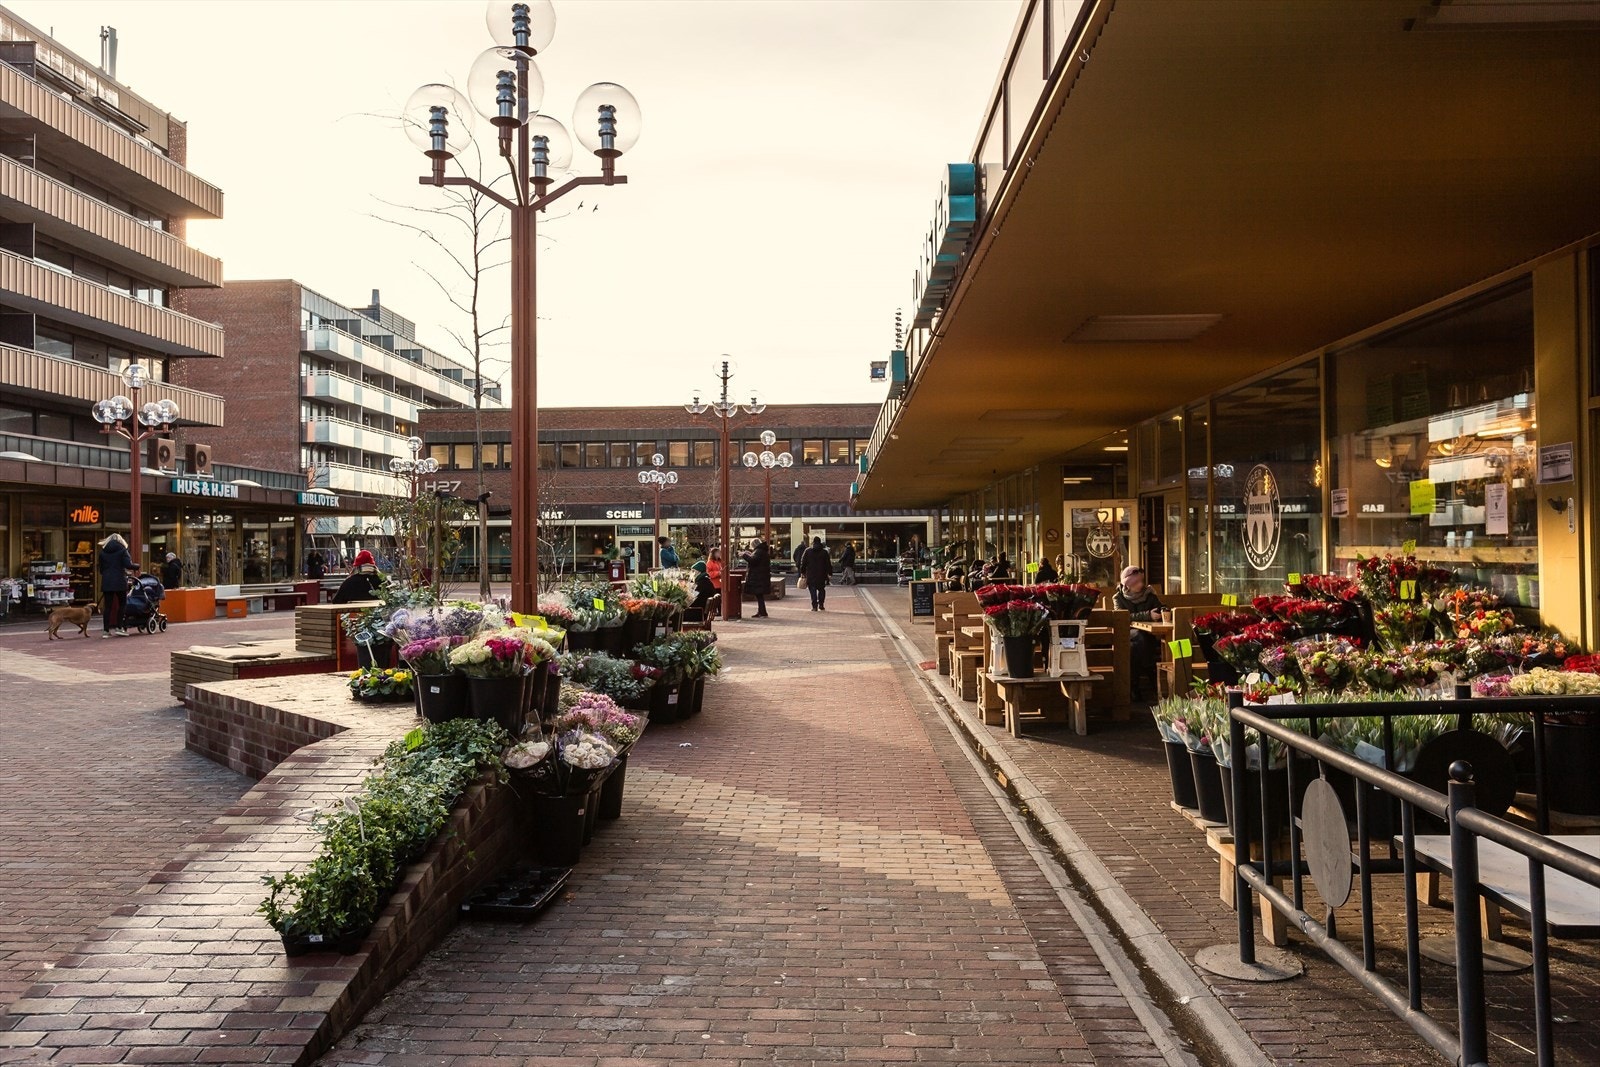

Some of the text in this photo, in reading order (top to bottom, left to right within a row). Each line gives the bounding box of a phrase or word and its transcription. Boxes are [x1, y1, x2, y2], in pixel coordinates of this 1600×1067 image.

[176, 479, 200, 495] HUS
[211, 483, 239, 499] HJEM
[424, 480, 462, 493] H27
[301, 493, 340, 507] BIBLIOTEK
[73, 505, 99, 523] nille
[605, 510, 643, 519] SCENE
